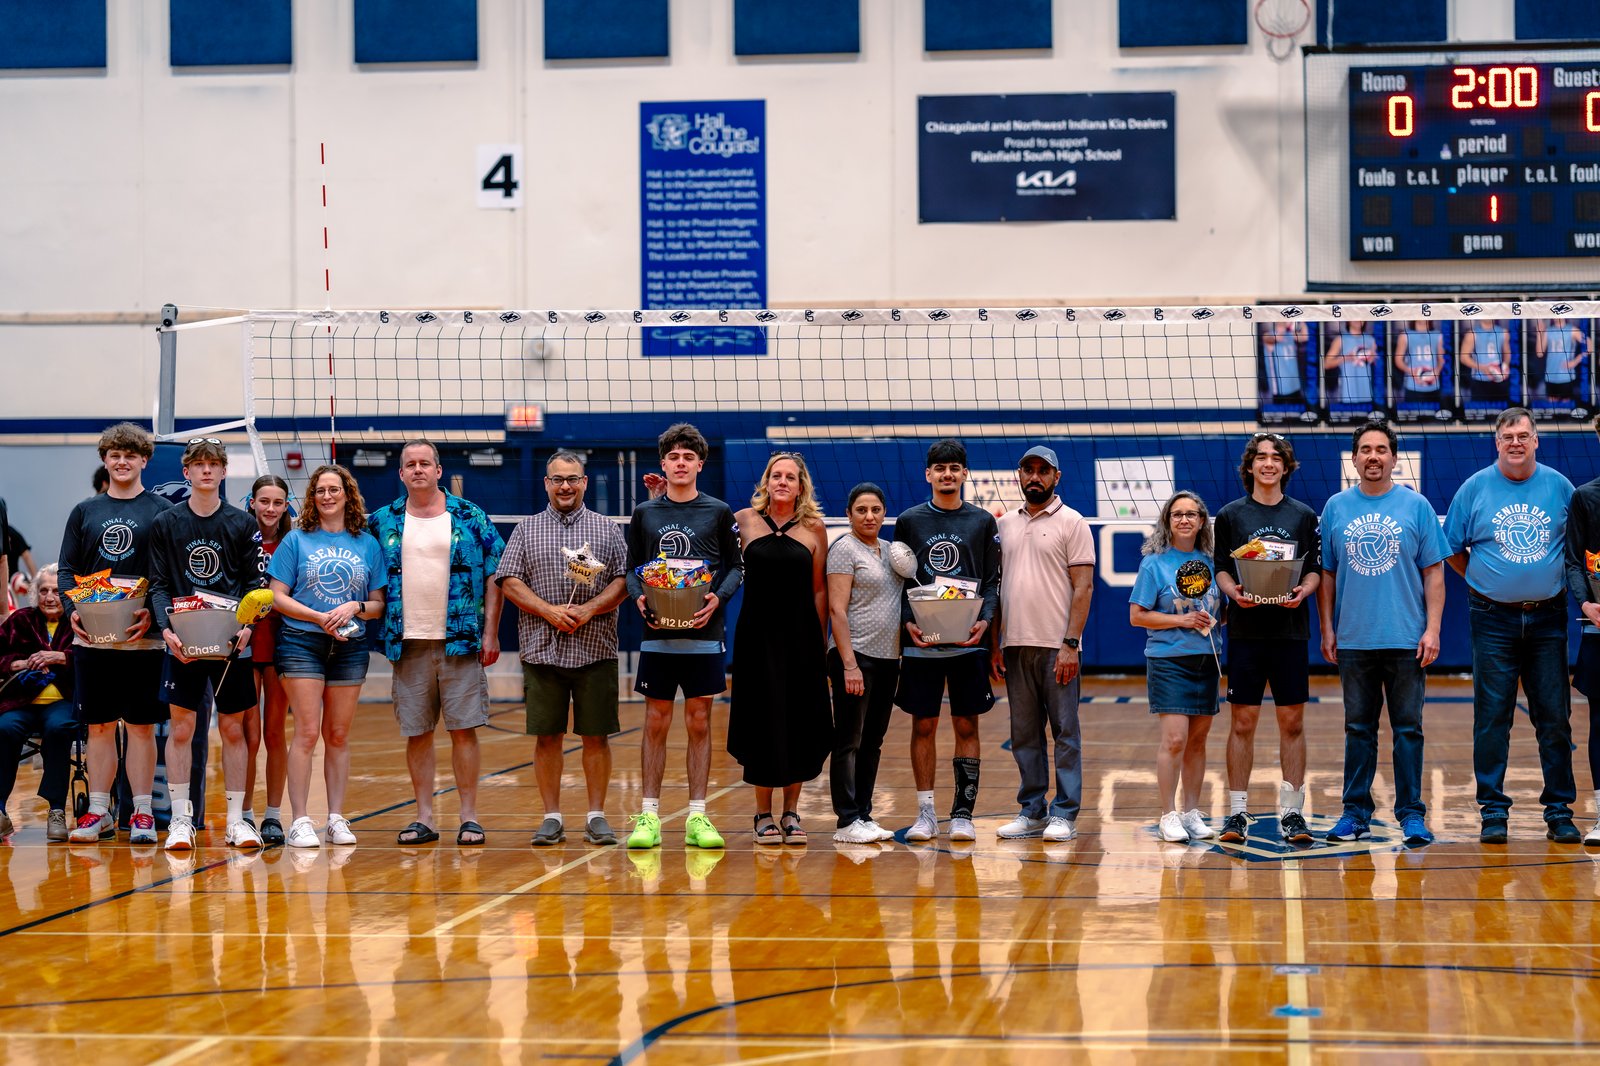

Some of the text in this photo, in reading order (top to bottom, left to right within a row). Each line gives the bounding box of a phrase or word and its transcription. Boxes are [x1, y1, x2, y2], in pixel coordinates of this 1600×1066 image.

[1361, 72, 1406, 92] Home
[1452, 67, 1538, 109] 2:00
[694, 112, 725, 129] Hail
[1388, 95, 1413, 137] 0
[702, 124, 748, 140] to the
[925, 118, 1168, 134] Chicagoland and Northwest Indiana Kia Dealers
[688, 136, 760, 158] Cougars!
[1004, 137, 1088, 149] Proud to support
[1458, 134, 1507, 157] period
[971, 149, 1122, 164] Plainfield South High School
[481, 153, 519, 199] 4
[1358, 168, 1396, 187] fouls
[1456, 165, 1508, 187] player
[1490, 195, 1497, 222] 1
[1362, 236, 1394, 252] won
[1463, 235, 1503, 254] game
[1492, 504, 1551, 525] SENIOR DAD
[1503, 517, 1514, 527] THE
[101, 518, 138, 529] FINAL SET
[658, 523, 695, 537] FINAL SET
[1343, 513, 1403, 537] SENIOR DAD
[926, 533, 962, 546] FINAL SET
[1253, 526, 1291, 539] FINAL SET
[1354, 527, 1365, 538] THE
[1494, 531, 1550, 542] 20 25
[186, 539, 222, 551] FINAL SET
[1345, 541, 1400, 554] 20 25
[308, 547, 361, 565] SENIOR
[1500, 547, 1548, 564] FINISH STRONG
[1348, 557, 1397, 576] FINISH STRONG
[312, 584, 325, 599] THE
[324, 596, 345, 605] FINAL
[1254, 592, 1293, 604] Dominic
[661, 616, 676, 627] #12
[94, 632, 118, 643] Jack
[188, 644, 220, 655] Chase
